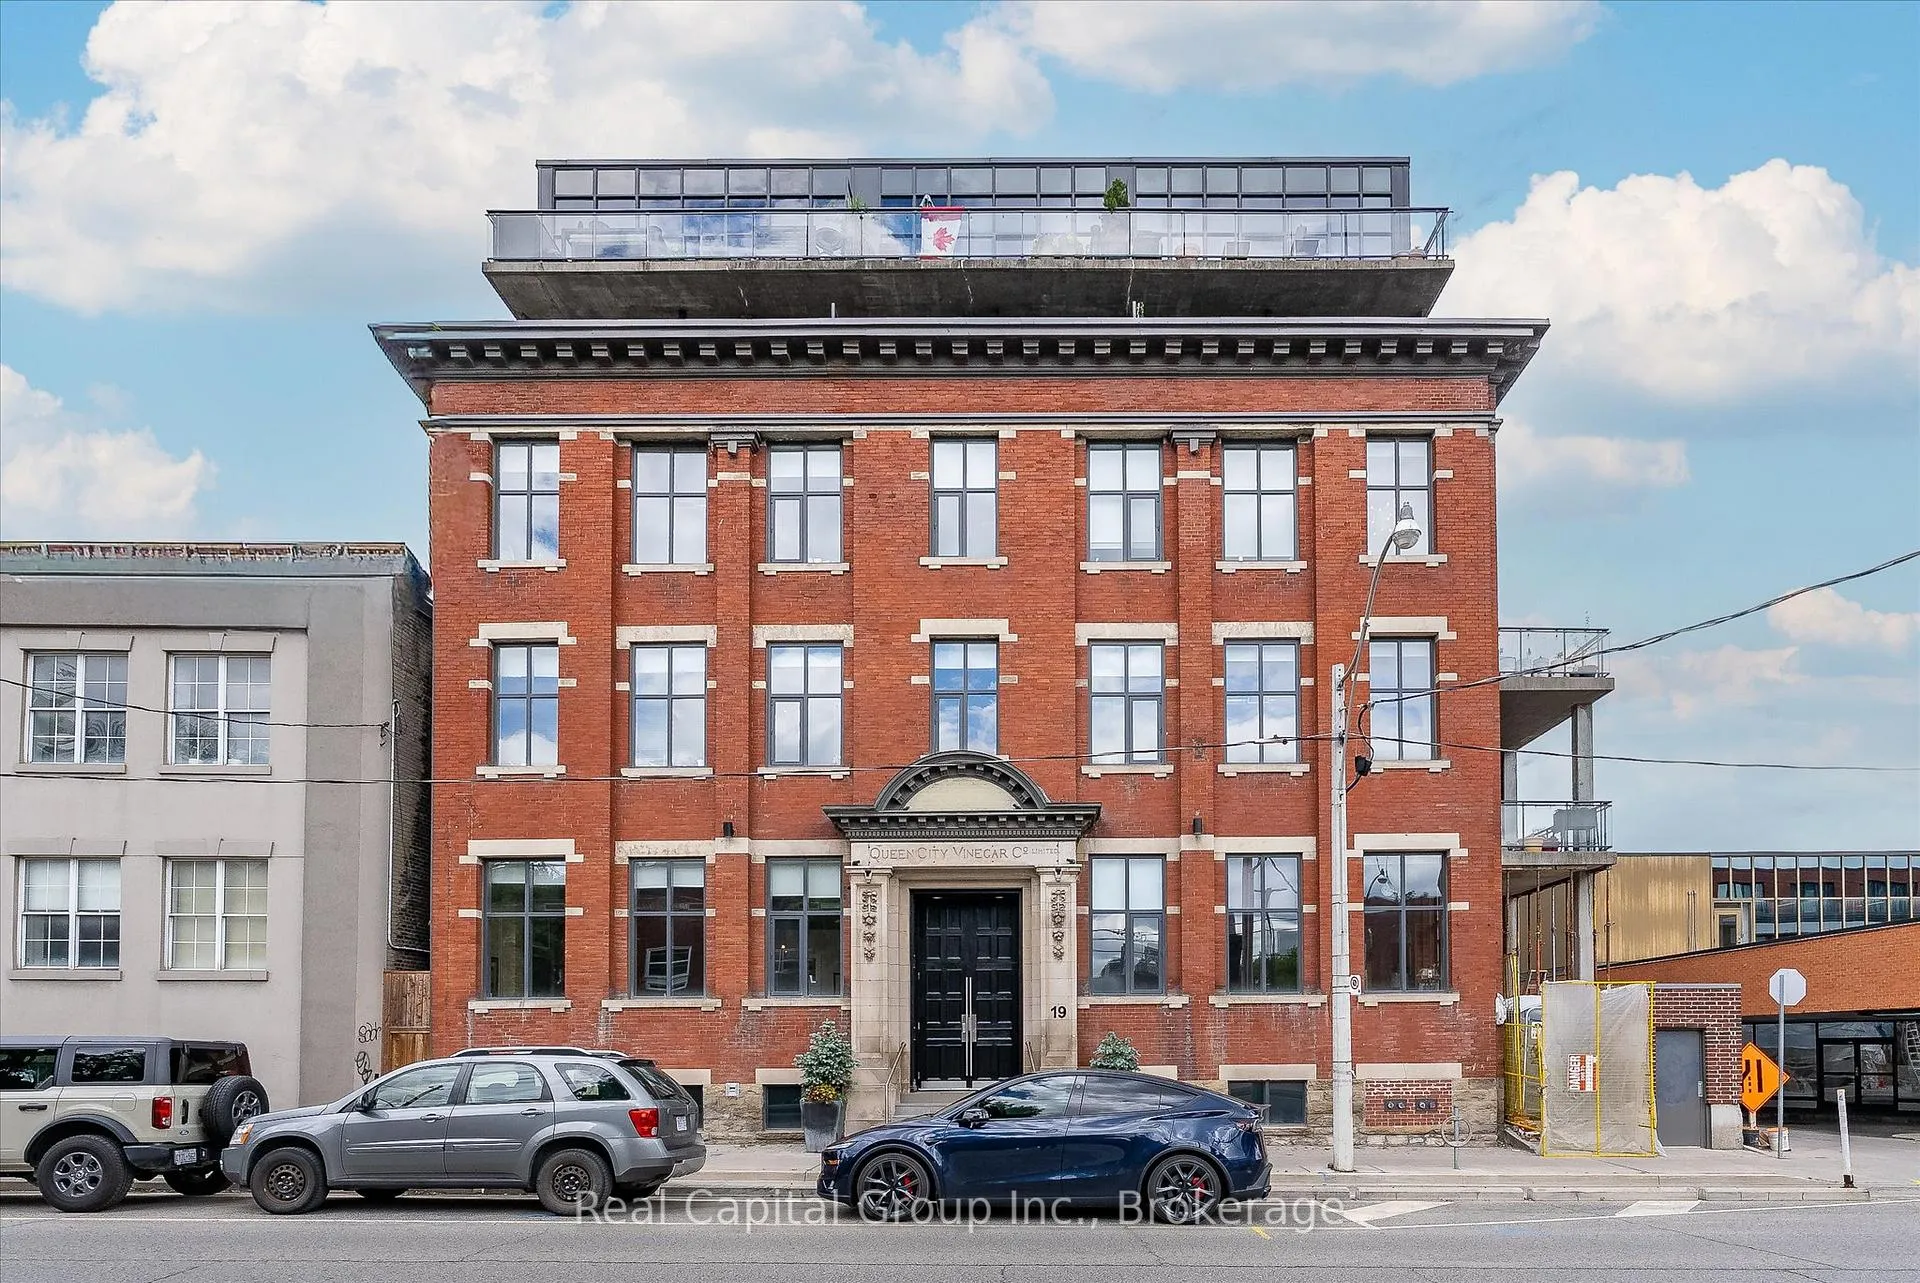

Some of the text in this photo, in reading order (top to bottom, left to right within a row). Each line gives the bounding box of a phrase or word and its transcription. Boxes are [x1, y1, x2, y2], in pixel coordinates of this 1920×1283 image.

[869, 847, 915, 862] QUEEN
[917, 847, 948, 859] CITY
[952, 846, 1008, 859] VINEGAR
[1050, 1005, 1067, 1019] 19
[1569, 1055, 1581, 1090] DANGER
